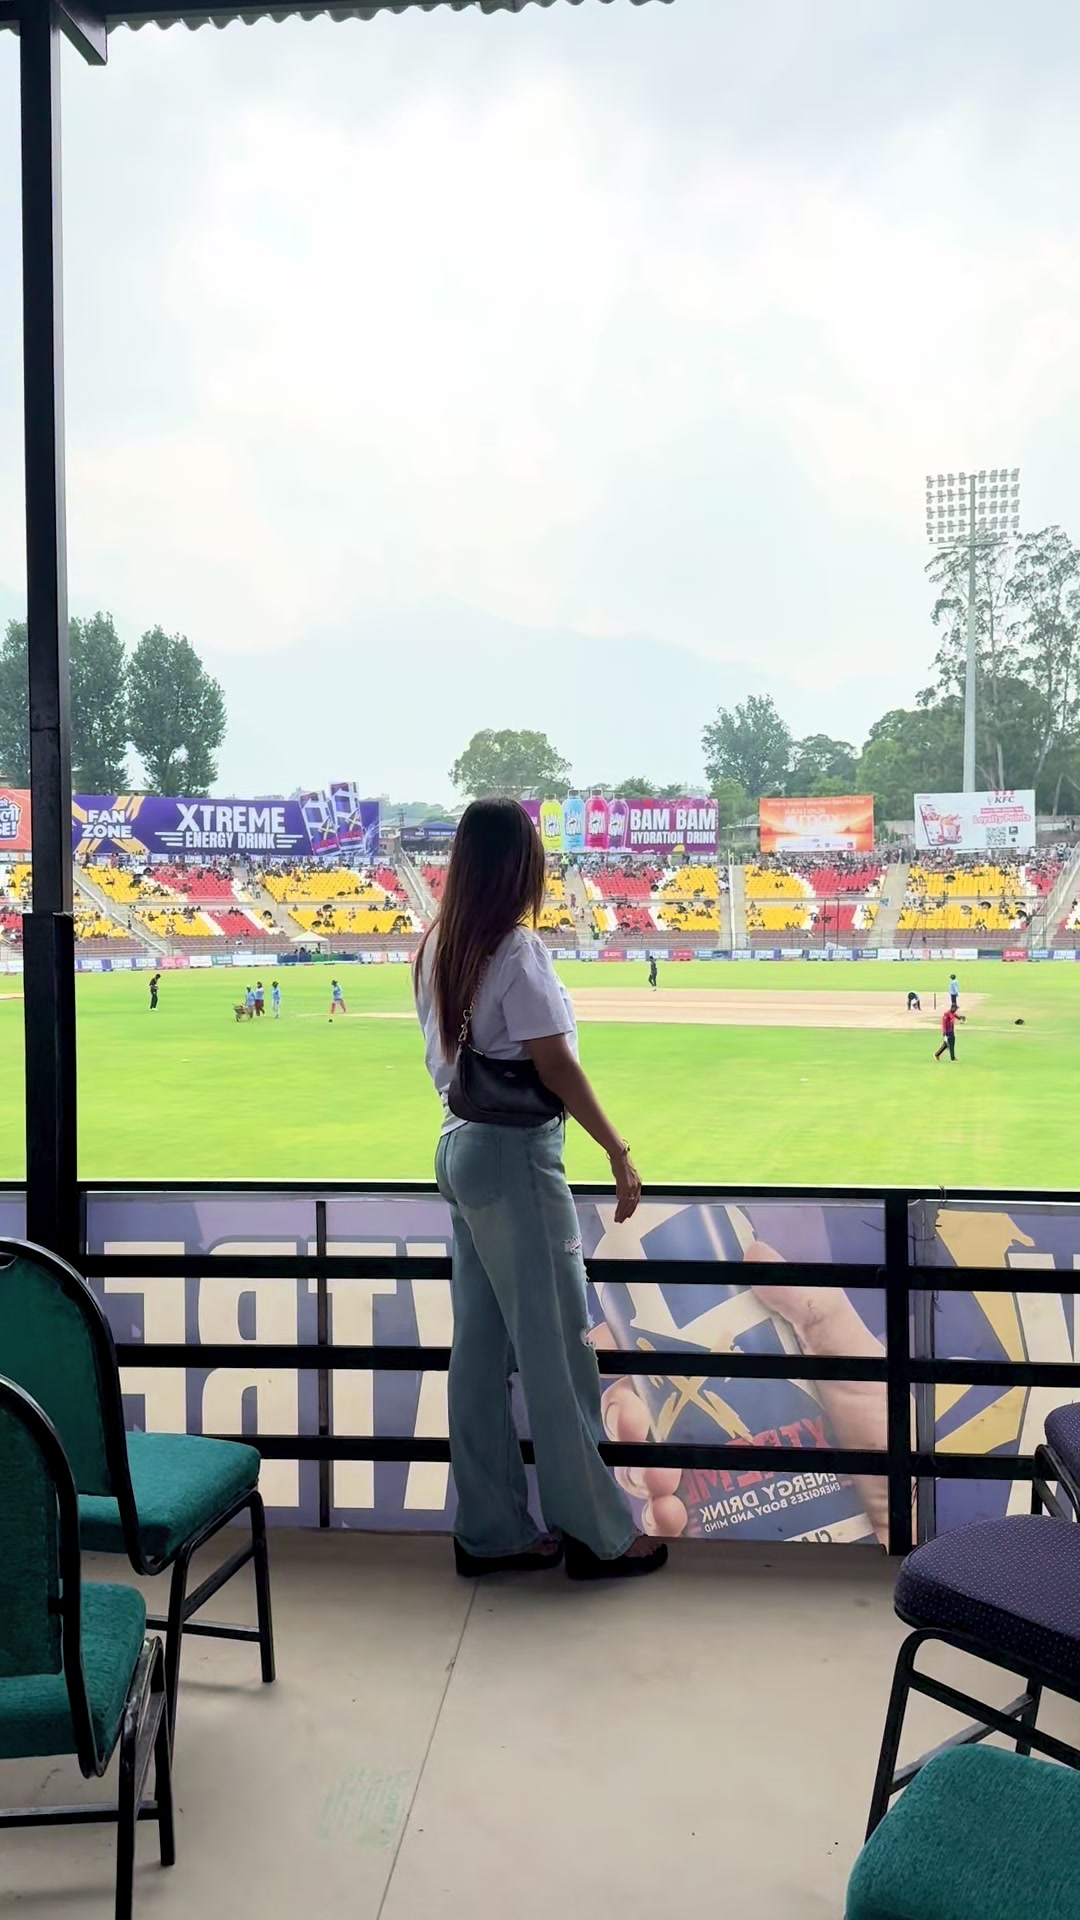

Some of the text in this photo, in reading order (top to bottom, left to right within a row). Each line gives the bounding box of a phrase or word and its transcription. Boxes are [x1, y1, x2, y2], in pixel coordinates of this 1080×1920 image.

[88, 809, 125, 823] FAN
[176, 803, 286, 833] XTREME
[630, 808, 670, 830] BAM
[676, 808, 716, 830] BAM
[973, 813, 1030, 824] Loyalty Points
[81, 824, 132, 838] ZONE
[630, 831, 716, 845] HYDRATION DRINK
[185, 832, 276, 850] ENERGY DRINK
